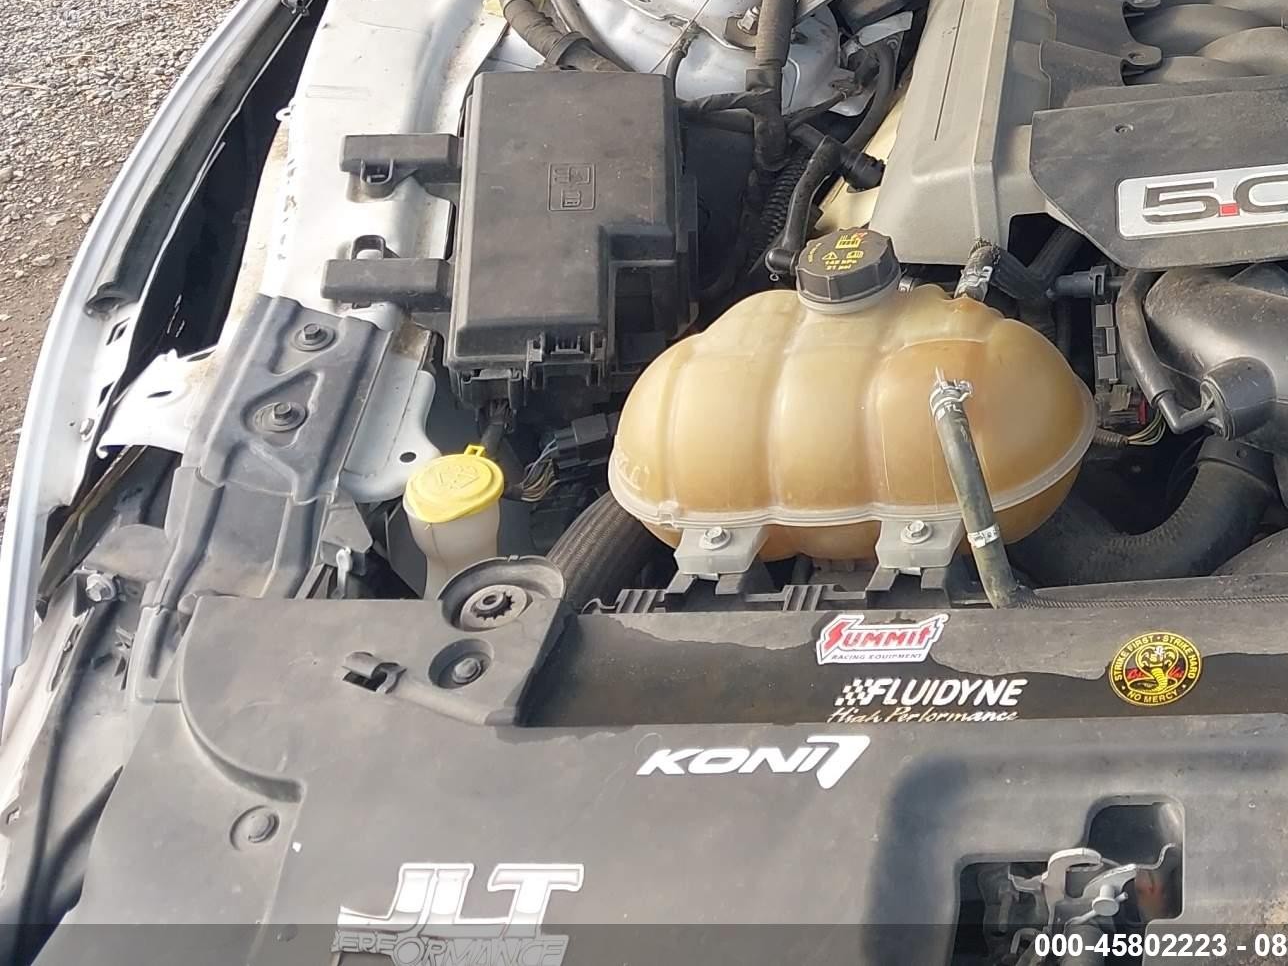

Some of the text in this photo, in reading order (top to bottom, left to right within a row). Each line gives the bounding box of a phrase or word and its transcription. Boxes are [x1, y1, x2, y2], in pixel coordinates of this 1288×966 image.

[1114, 651, 1129, 682] STRIKE
[1128, 635, 1154, 652] FIRST
[1163, 635, 1198, 679] STRIKE HARD
[868, 679, 1028, 706] FLUIDYNE
[1127, 689, 1179, 703] NO MERCY
[337, 864, 584, 939] JLT
